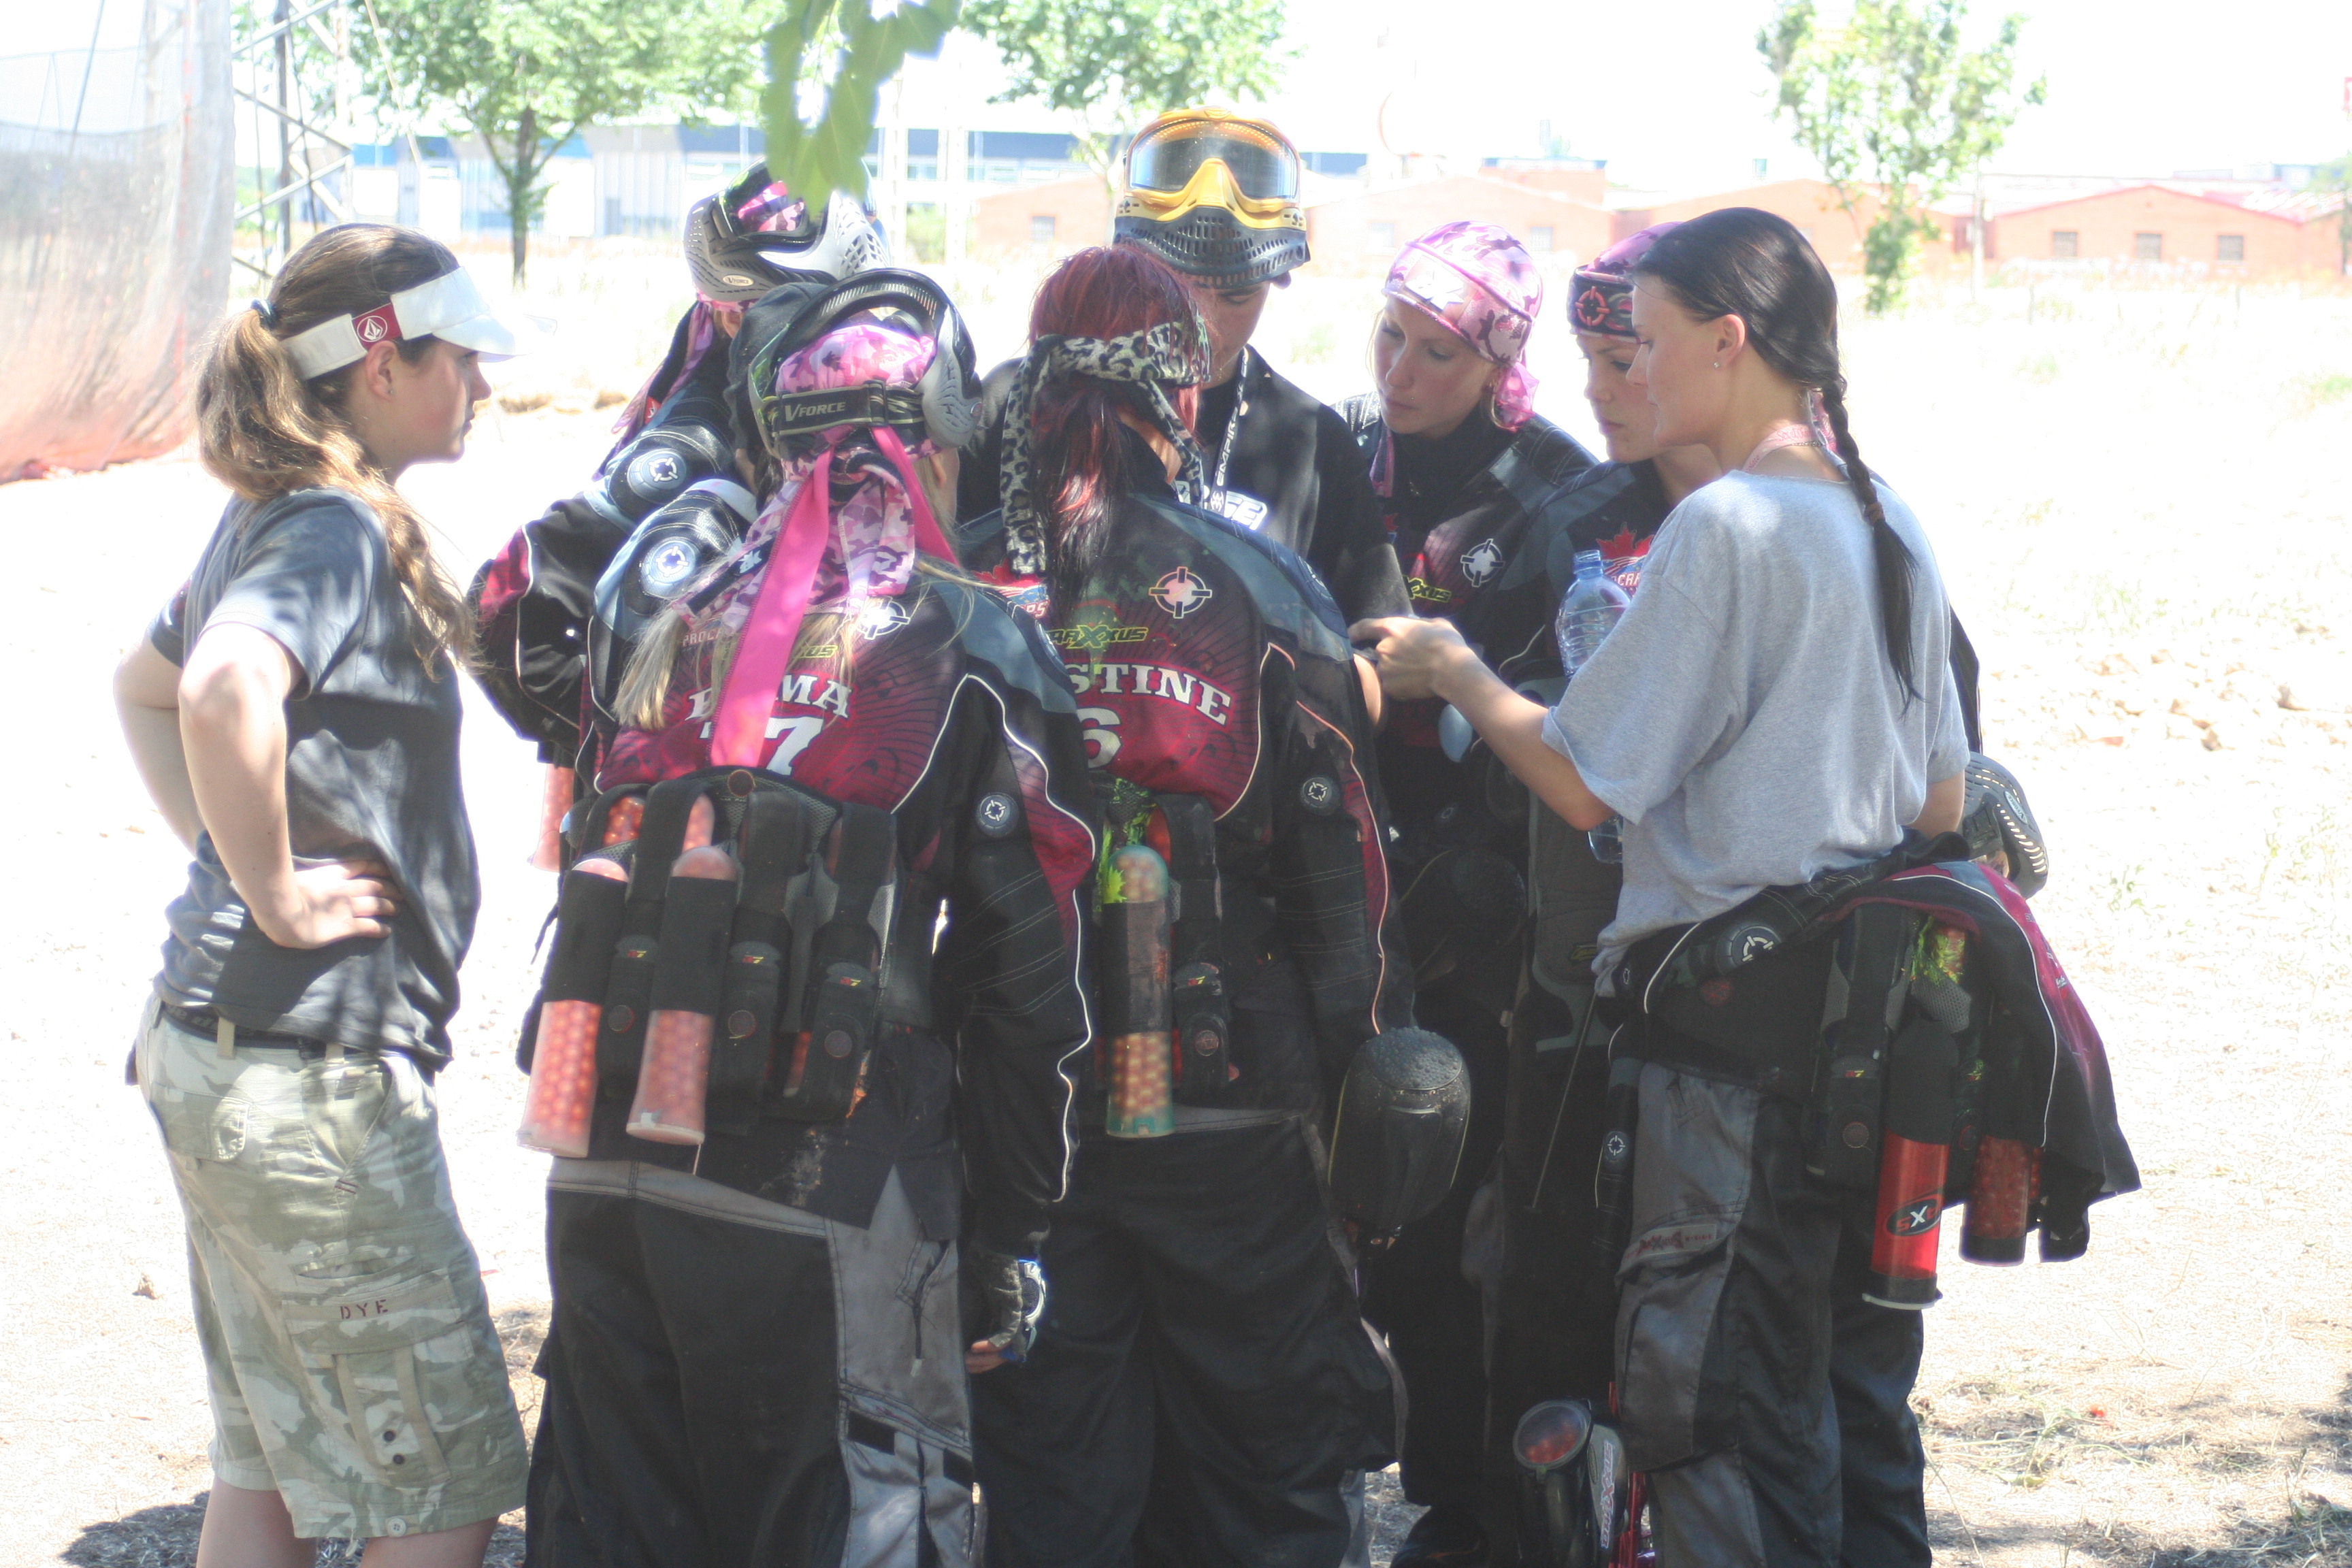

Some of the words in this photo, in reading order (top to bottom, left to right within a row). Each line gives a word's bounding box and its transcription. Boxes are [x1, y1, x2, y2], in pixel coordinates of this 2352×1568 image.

[785, 402, 846, 421] VFORCE
[1065, 664, 1231, 725] STINE
[1076, 707, 1122, 769] 6
[340, 1298, 389, 1320] DYE
